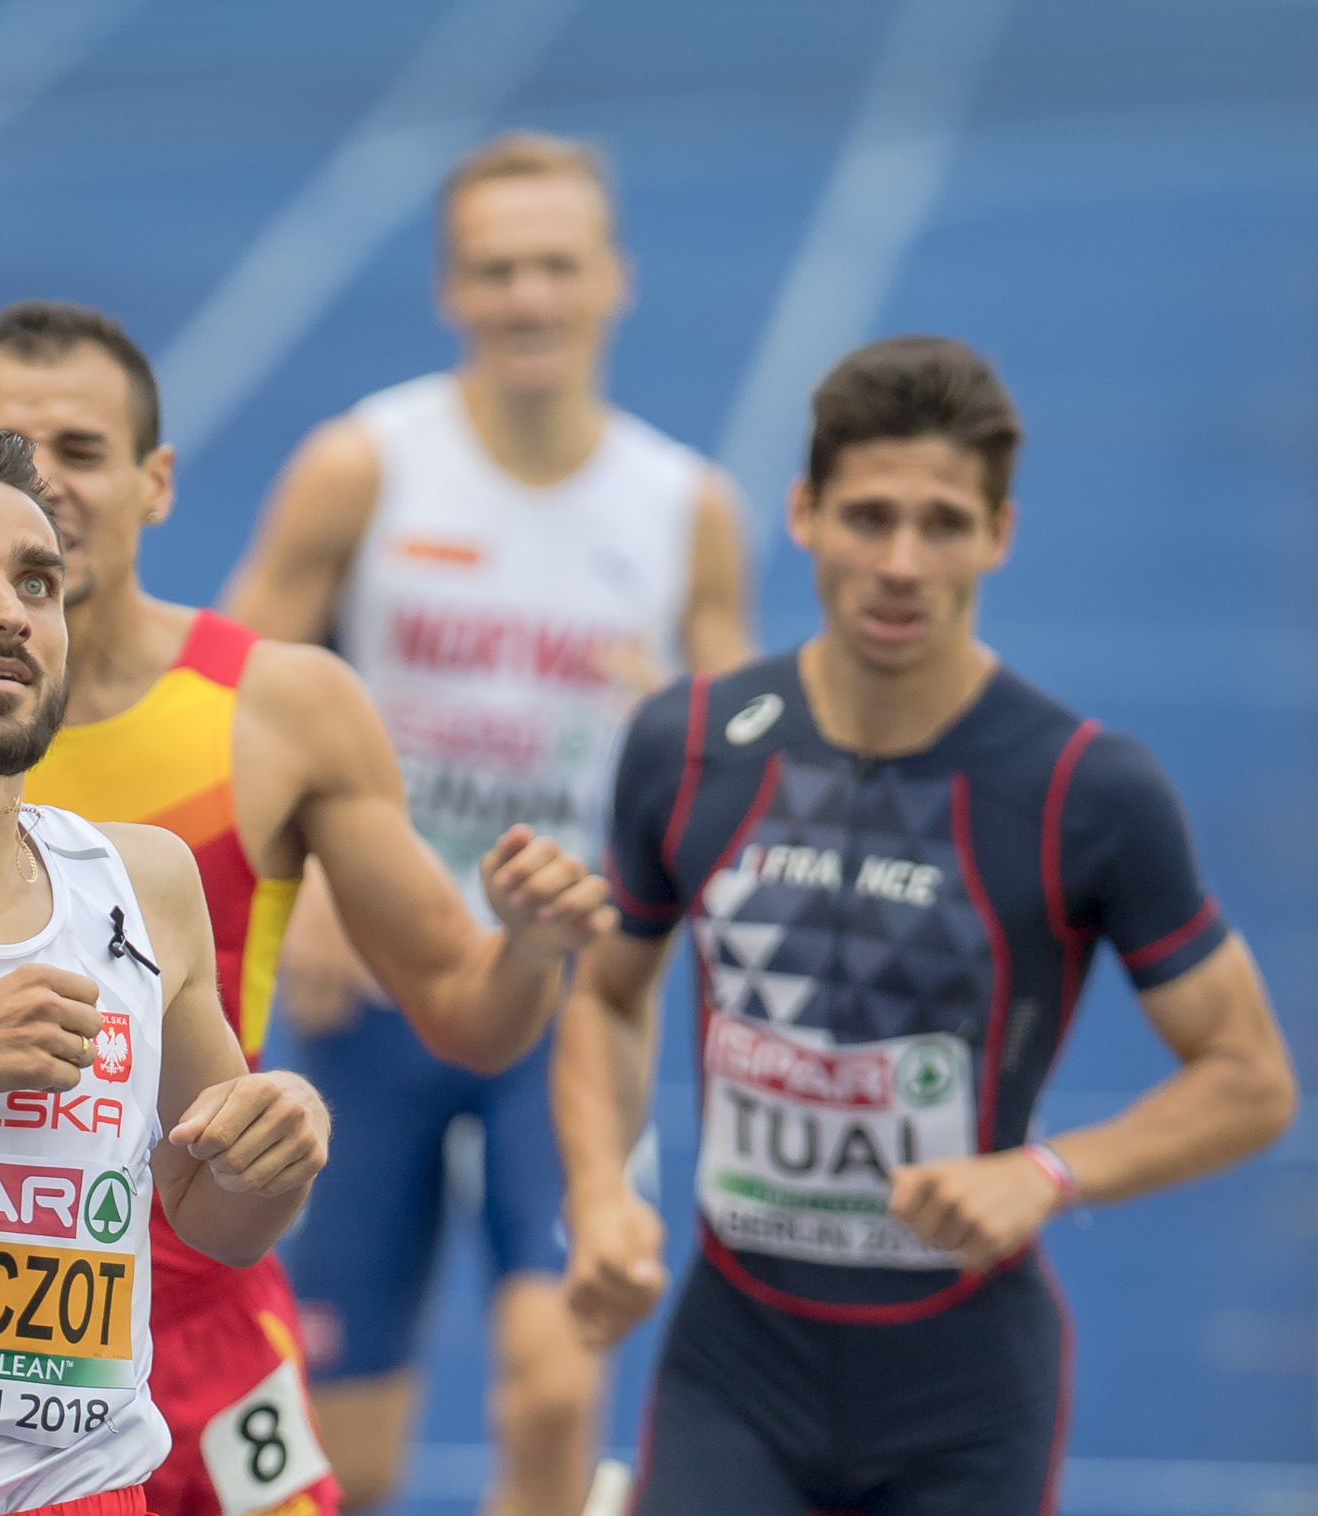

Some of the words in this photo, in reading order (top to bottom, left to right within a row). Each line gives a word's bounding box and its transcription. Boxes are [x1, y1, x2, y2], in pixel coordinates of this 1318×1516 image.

[99, 1014, 128, 1026] OLSKA
[15, 1392, 111, 1434] 2018
[239, 1405, 288, 1483] 8
